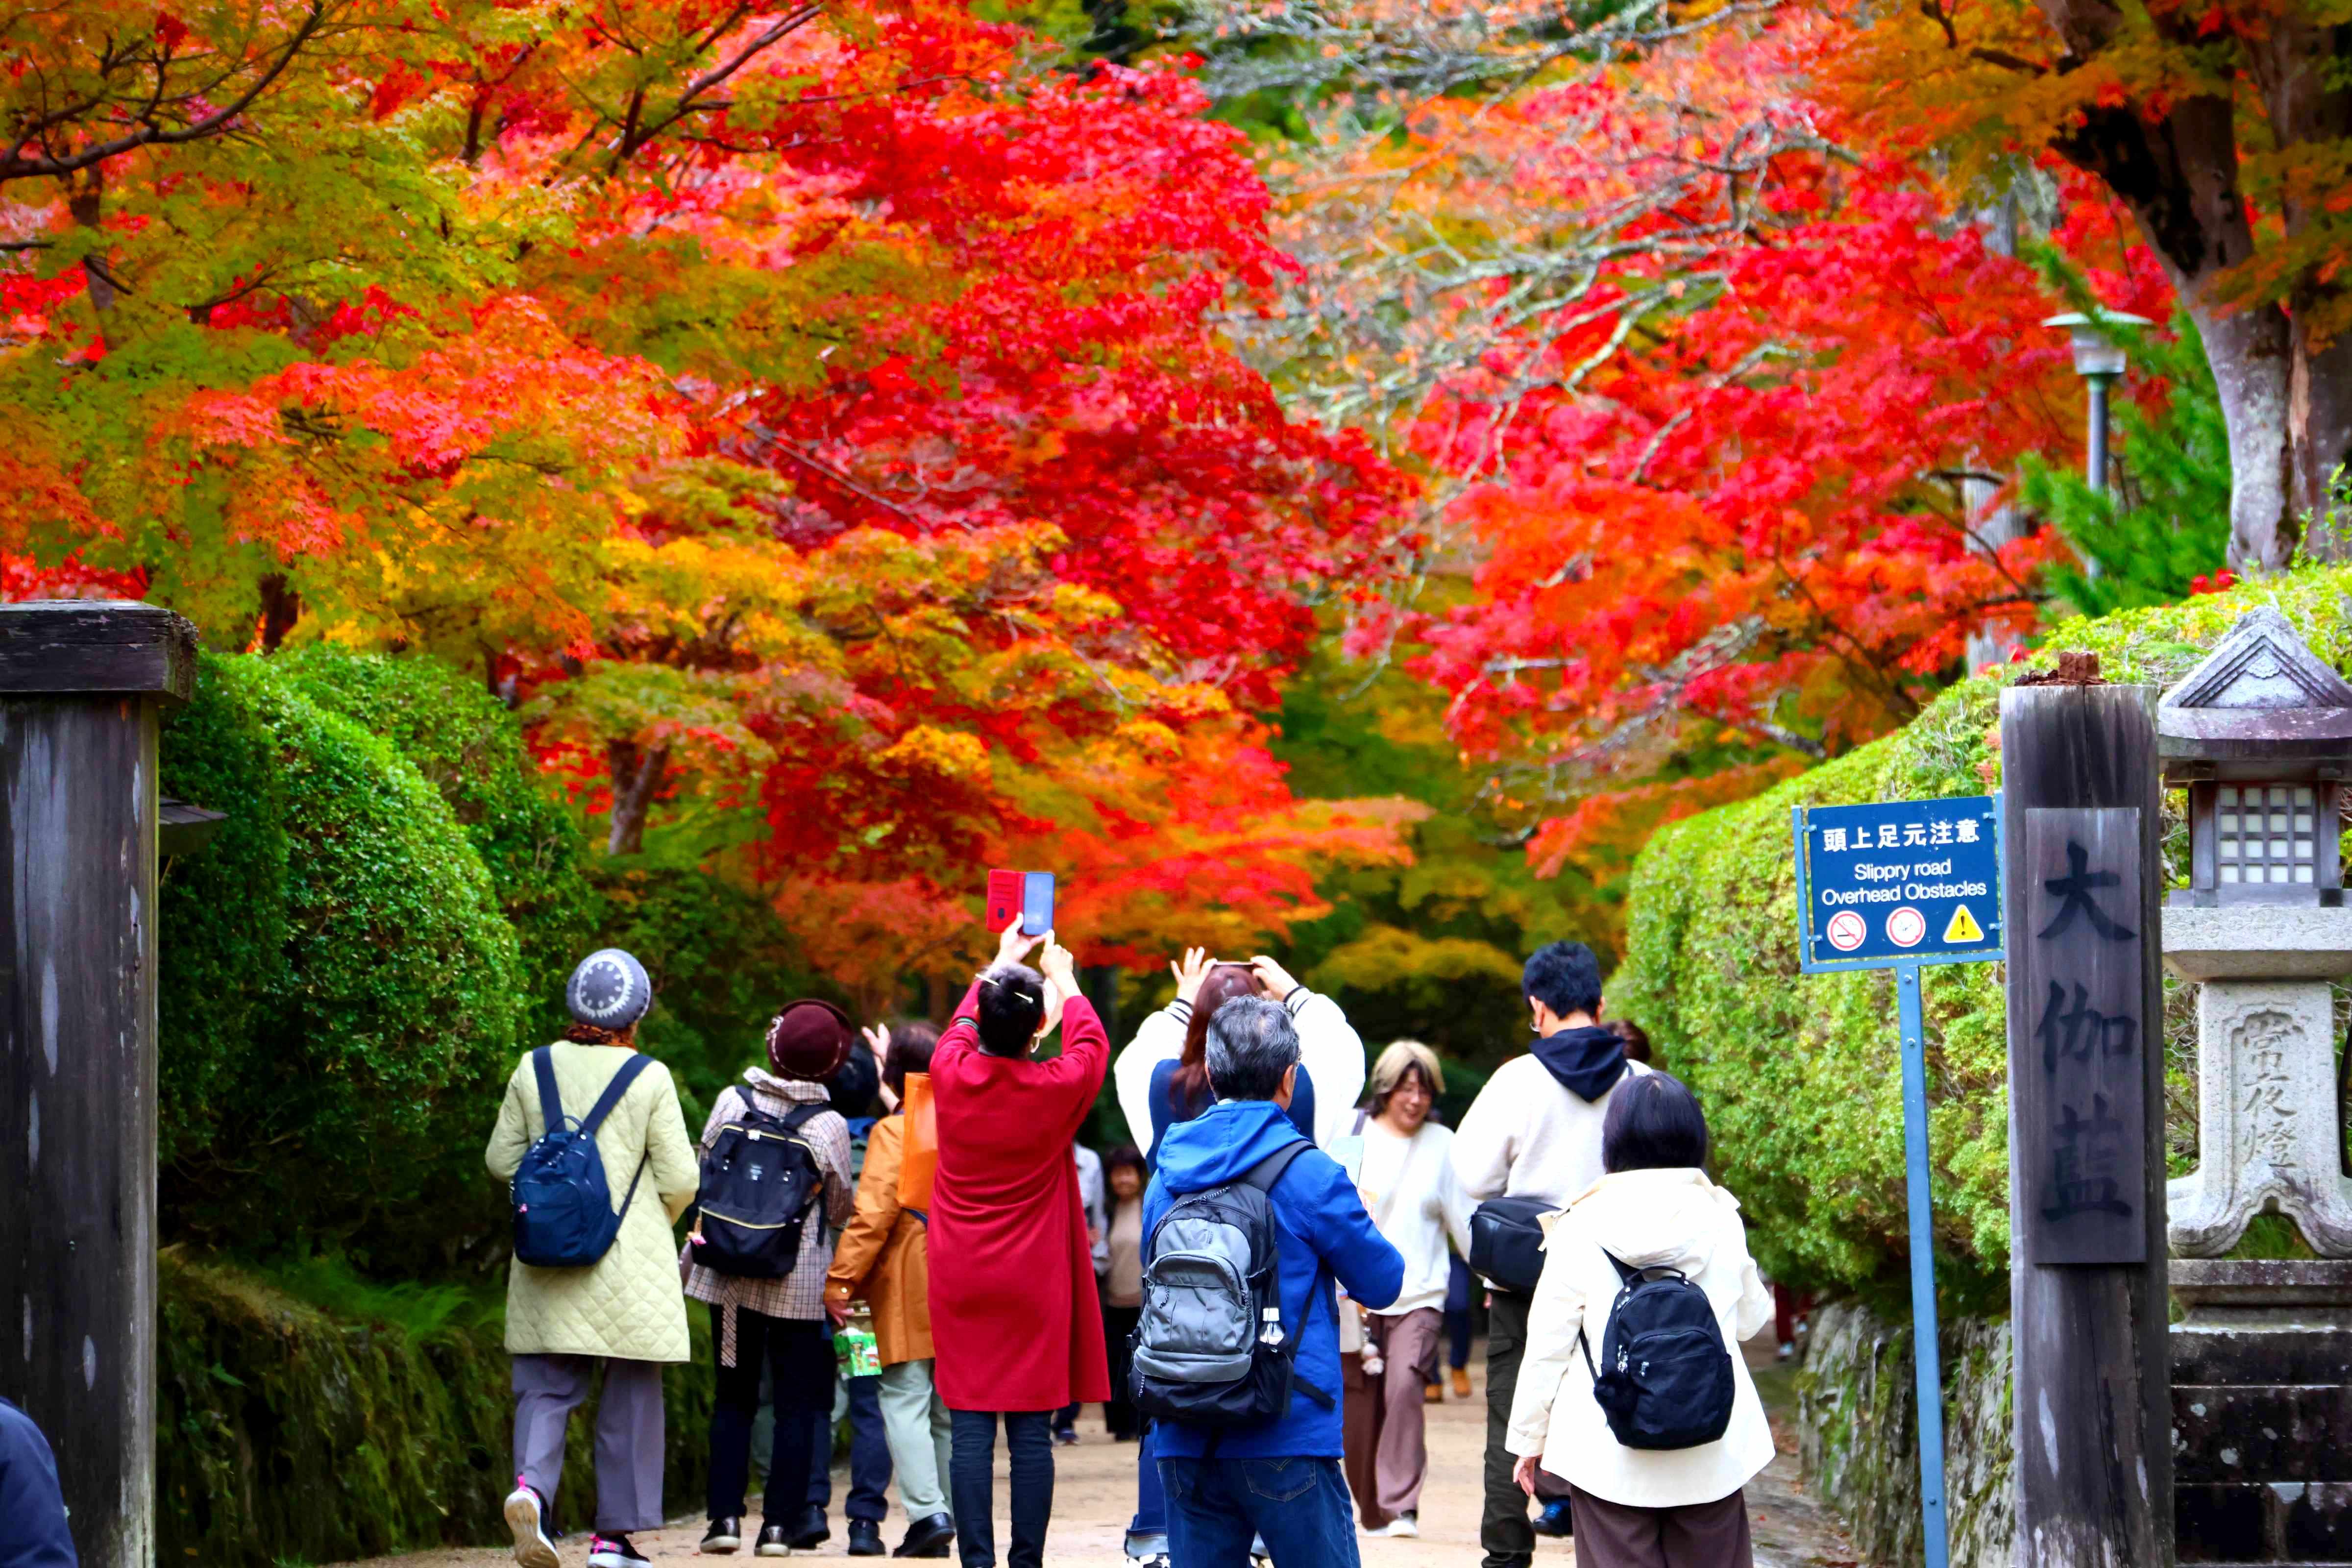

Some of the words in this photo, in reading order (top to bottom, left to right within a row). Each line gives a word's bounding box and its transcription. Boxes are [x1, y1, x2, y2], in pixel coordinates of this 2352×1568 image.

[1823, 819, 1980, 852] 頭上足元注意
[1854, 864, 1911, 882] Slippry
[1914, 859, 1951, 876] road
[1822, 885, 1901, 906] Overhead
[1905, 881, 1986, 901] Obstacles
[2035, 841, 2137, 1222] 大伽藍
